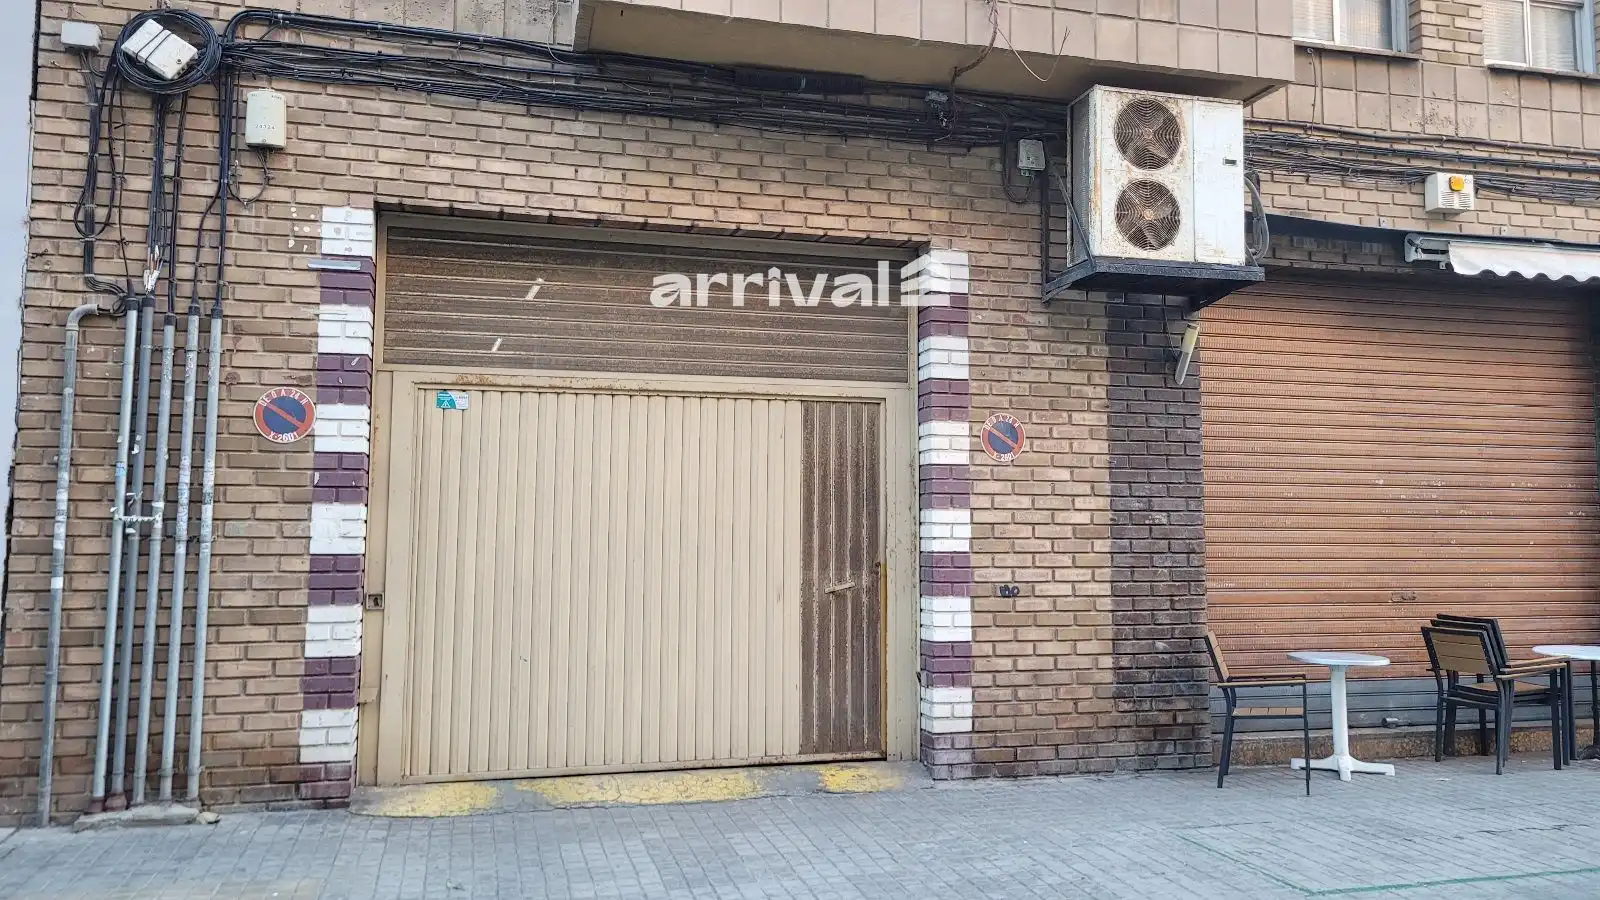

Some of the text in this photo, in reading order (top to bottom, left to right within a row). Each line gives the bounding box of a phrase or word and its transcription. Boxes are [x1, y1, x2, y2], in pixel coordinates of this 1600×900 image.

[258, 396, 271, 407] DE
[280, 388, 286, 397] A
[290, 390, 301, 400] 24
[998, 414, 1004, 422] A
